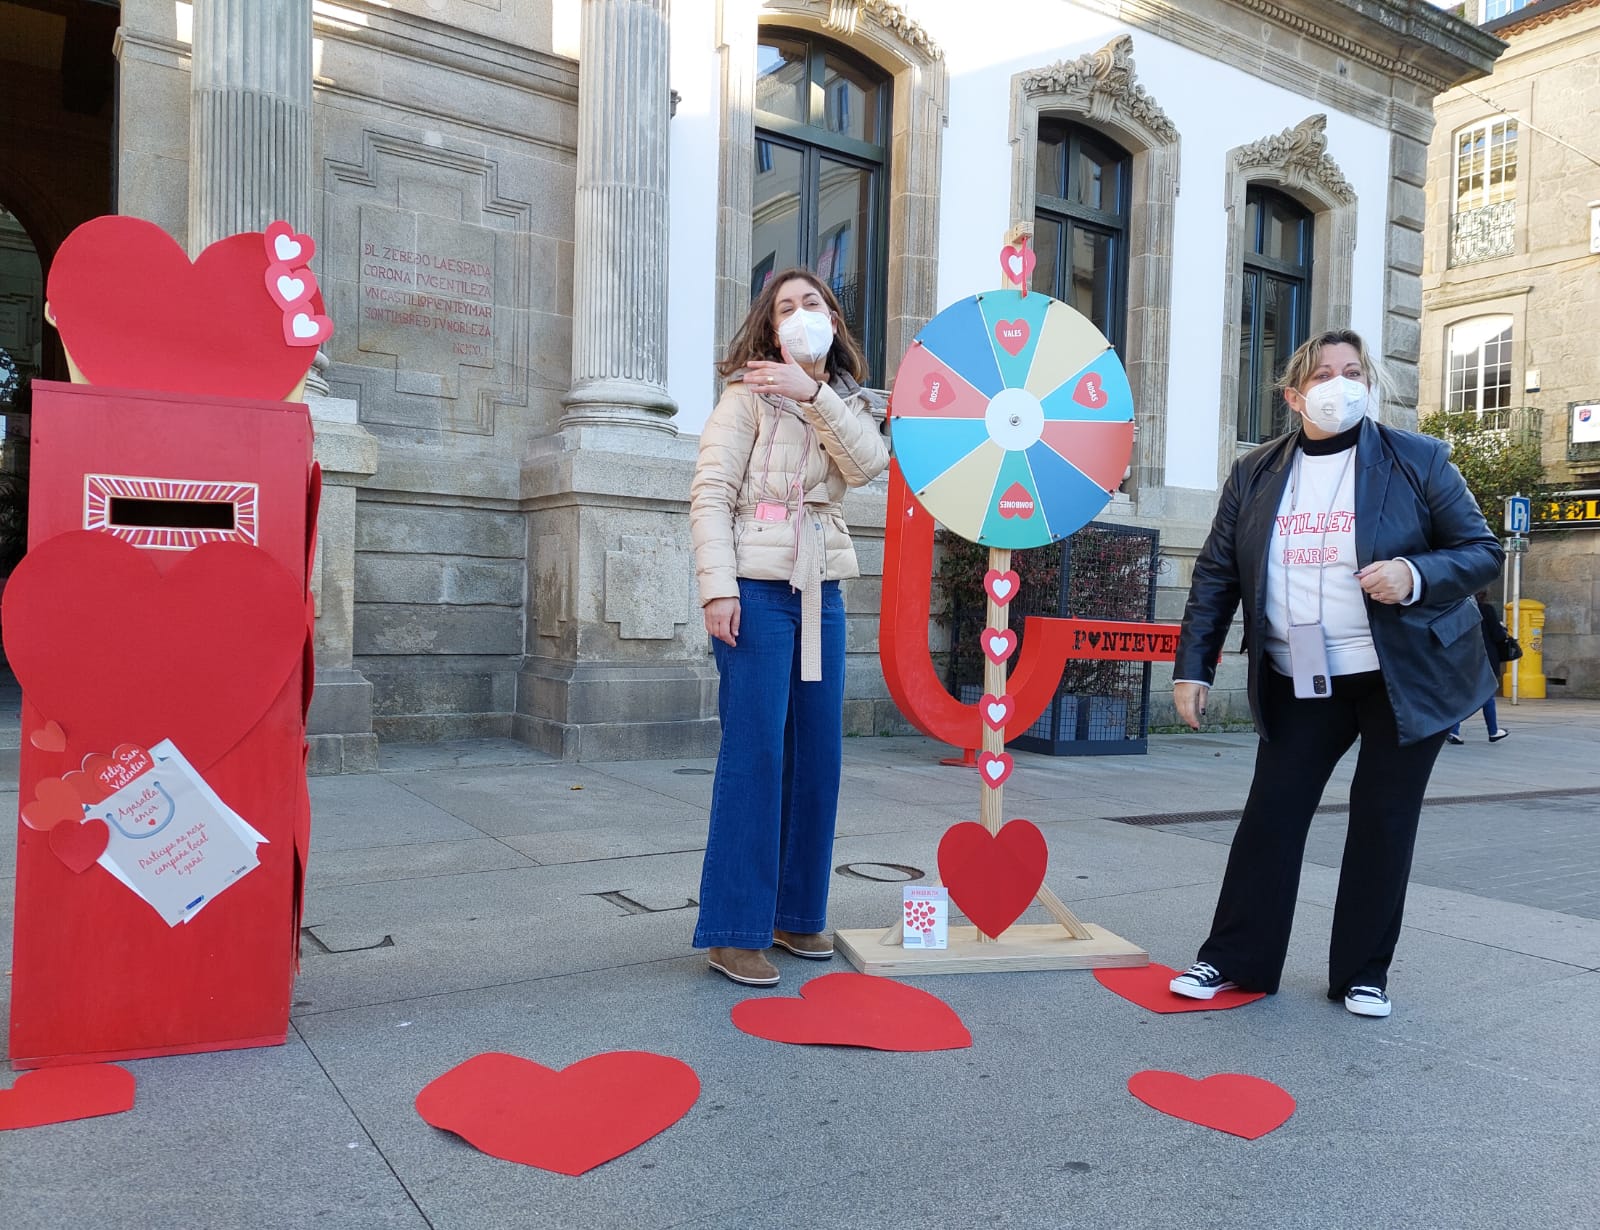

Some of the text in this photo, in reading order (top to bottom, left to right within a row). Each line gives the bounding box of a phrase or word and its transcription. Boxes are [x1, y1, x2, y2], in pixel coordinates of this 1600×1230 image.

[1003, 329, 1022, 337] VALES
[929, 381, 940, 403] ROSAS
[1086, 381, 1099, 402] ROSAS
[1000, 500, 1033, 508] BOMBONES
[1283, 547, 1338, 564] PARIS
[100, 748, 140, 783] Feliz San
[134, 805, 159, 824] amor
[186, 830, 209, 851] local
[138, 842, 176, 869] Participa
